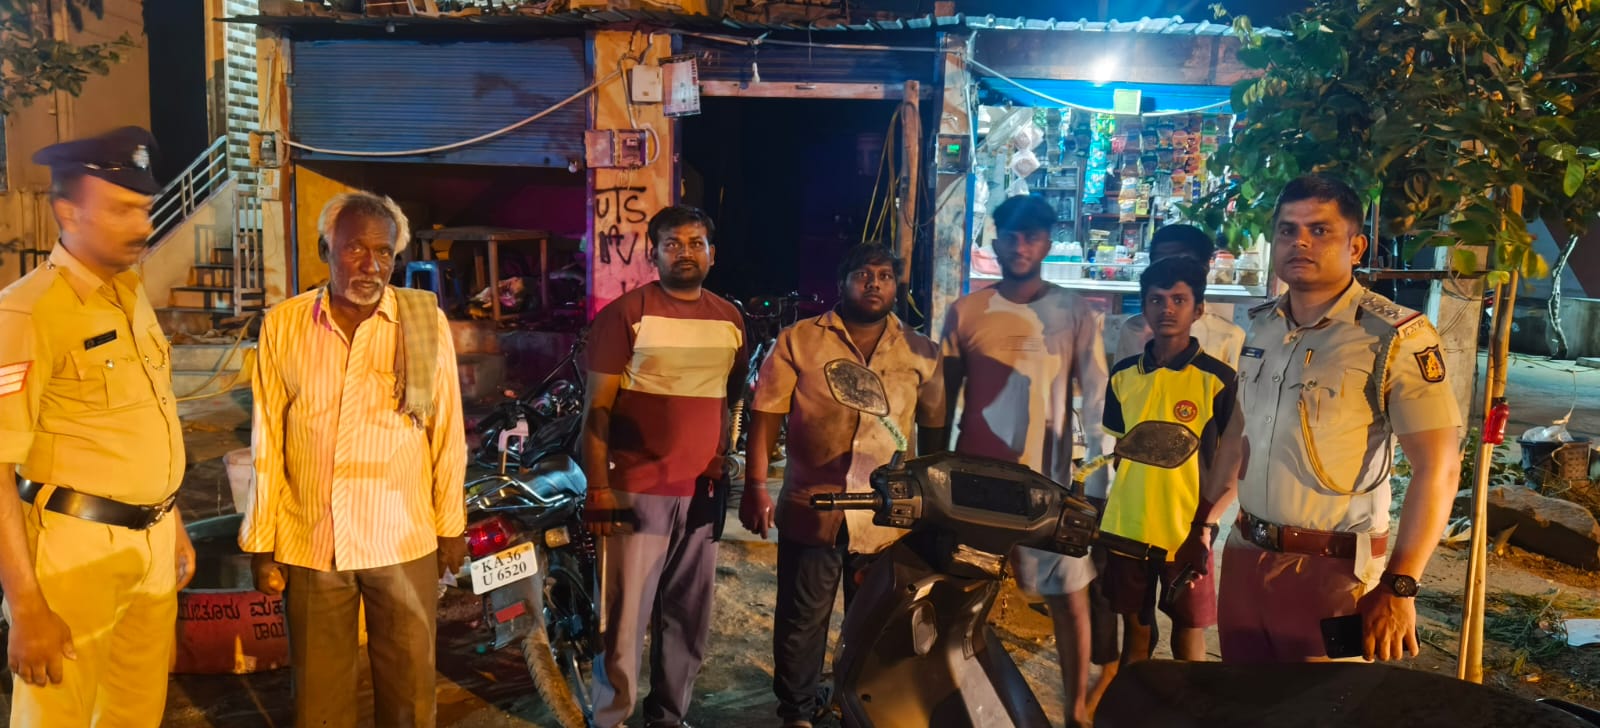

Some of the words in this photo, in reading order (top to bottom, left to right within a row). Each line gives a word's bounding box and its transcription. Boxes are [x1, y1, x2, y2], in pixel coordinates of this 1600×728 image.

[482, 556, 504, 573] KA
[506, 550, 521, 564] 36
[482, 573, 493, 586] U
[497, 561, 527, 581] 6520
[253, 618, 287, 640] ರಾಯ
